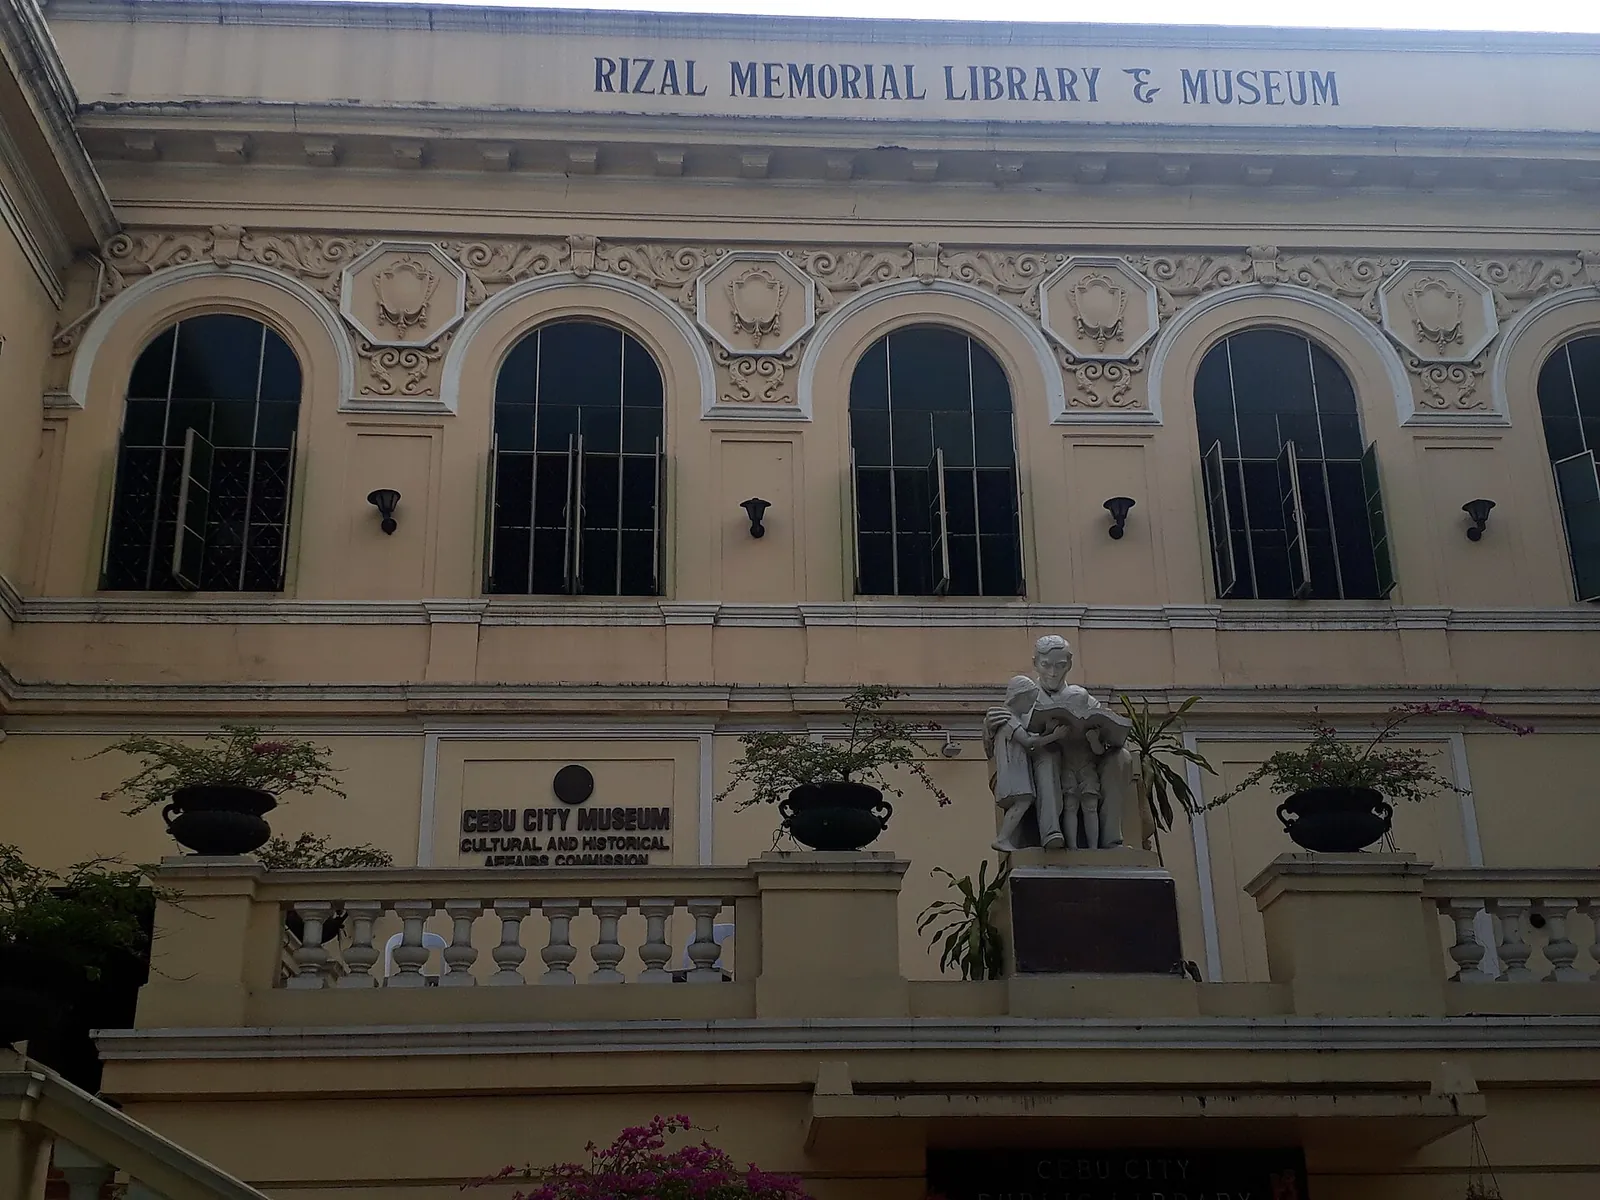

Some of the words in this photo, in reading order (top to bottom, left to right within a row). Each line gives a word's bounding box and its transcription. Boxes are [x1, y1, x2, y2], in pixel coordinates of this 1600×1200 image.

[593, 57, 708, 97] RIZAL
[729, 61, 926, 100] MEMORIAL
[943, 65, 1101, 102] LIBRARY
[1122, 68, 1162, 104] &
[1180, 69, 1340, 106] MUSEUM
[463, 809, 517, 832] CEBU
[523, 808, 570, 831] CITY
[577, 807, 670, 831] MUSEUM
[461, 837, 542, 852] CULTURAL
[547, 837, 578, 851] AND
[582, 836, 670, 851] HISTORICAL
[485, 855, 549, 867] AFFAIRS
[555, 854, 649, 866] COMMISSION
[1037, 1159, 1110, 1180] CEBU
[1125, 1159, 1190, 1180] CITY
